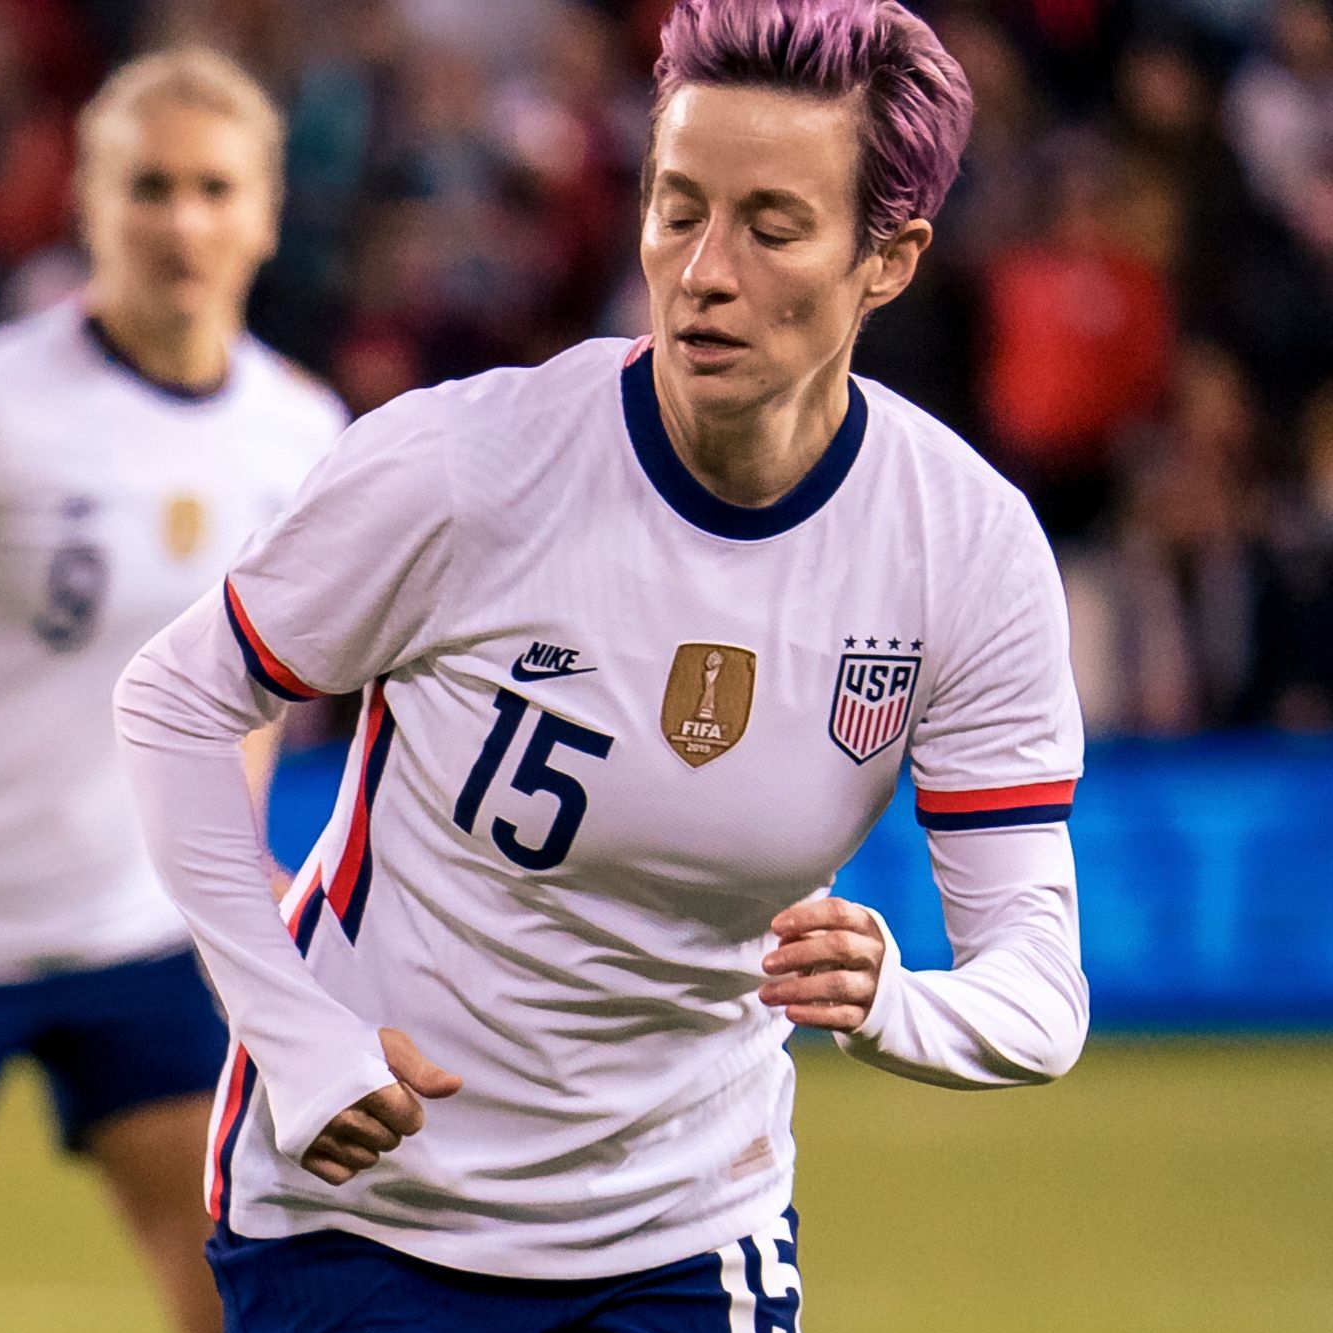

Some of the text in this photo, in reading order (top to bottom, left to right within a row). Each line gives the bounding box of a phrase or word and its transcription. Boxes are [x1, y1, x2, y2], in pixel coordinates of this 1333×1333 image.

[523, 641, 580, 672] NIKE
[845, 664, 912, 702] USA
[681, 720, 722, 740] FIFA
[453, 687, 615, 872] 15
